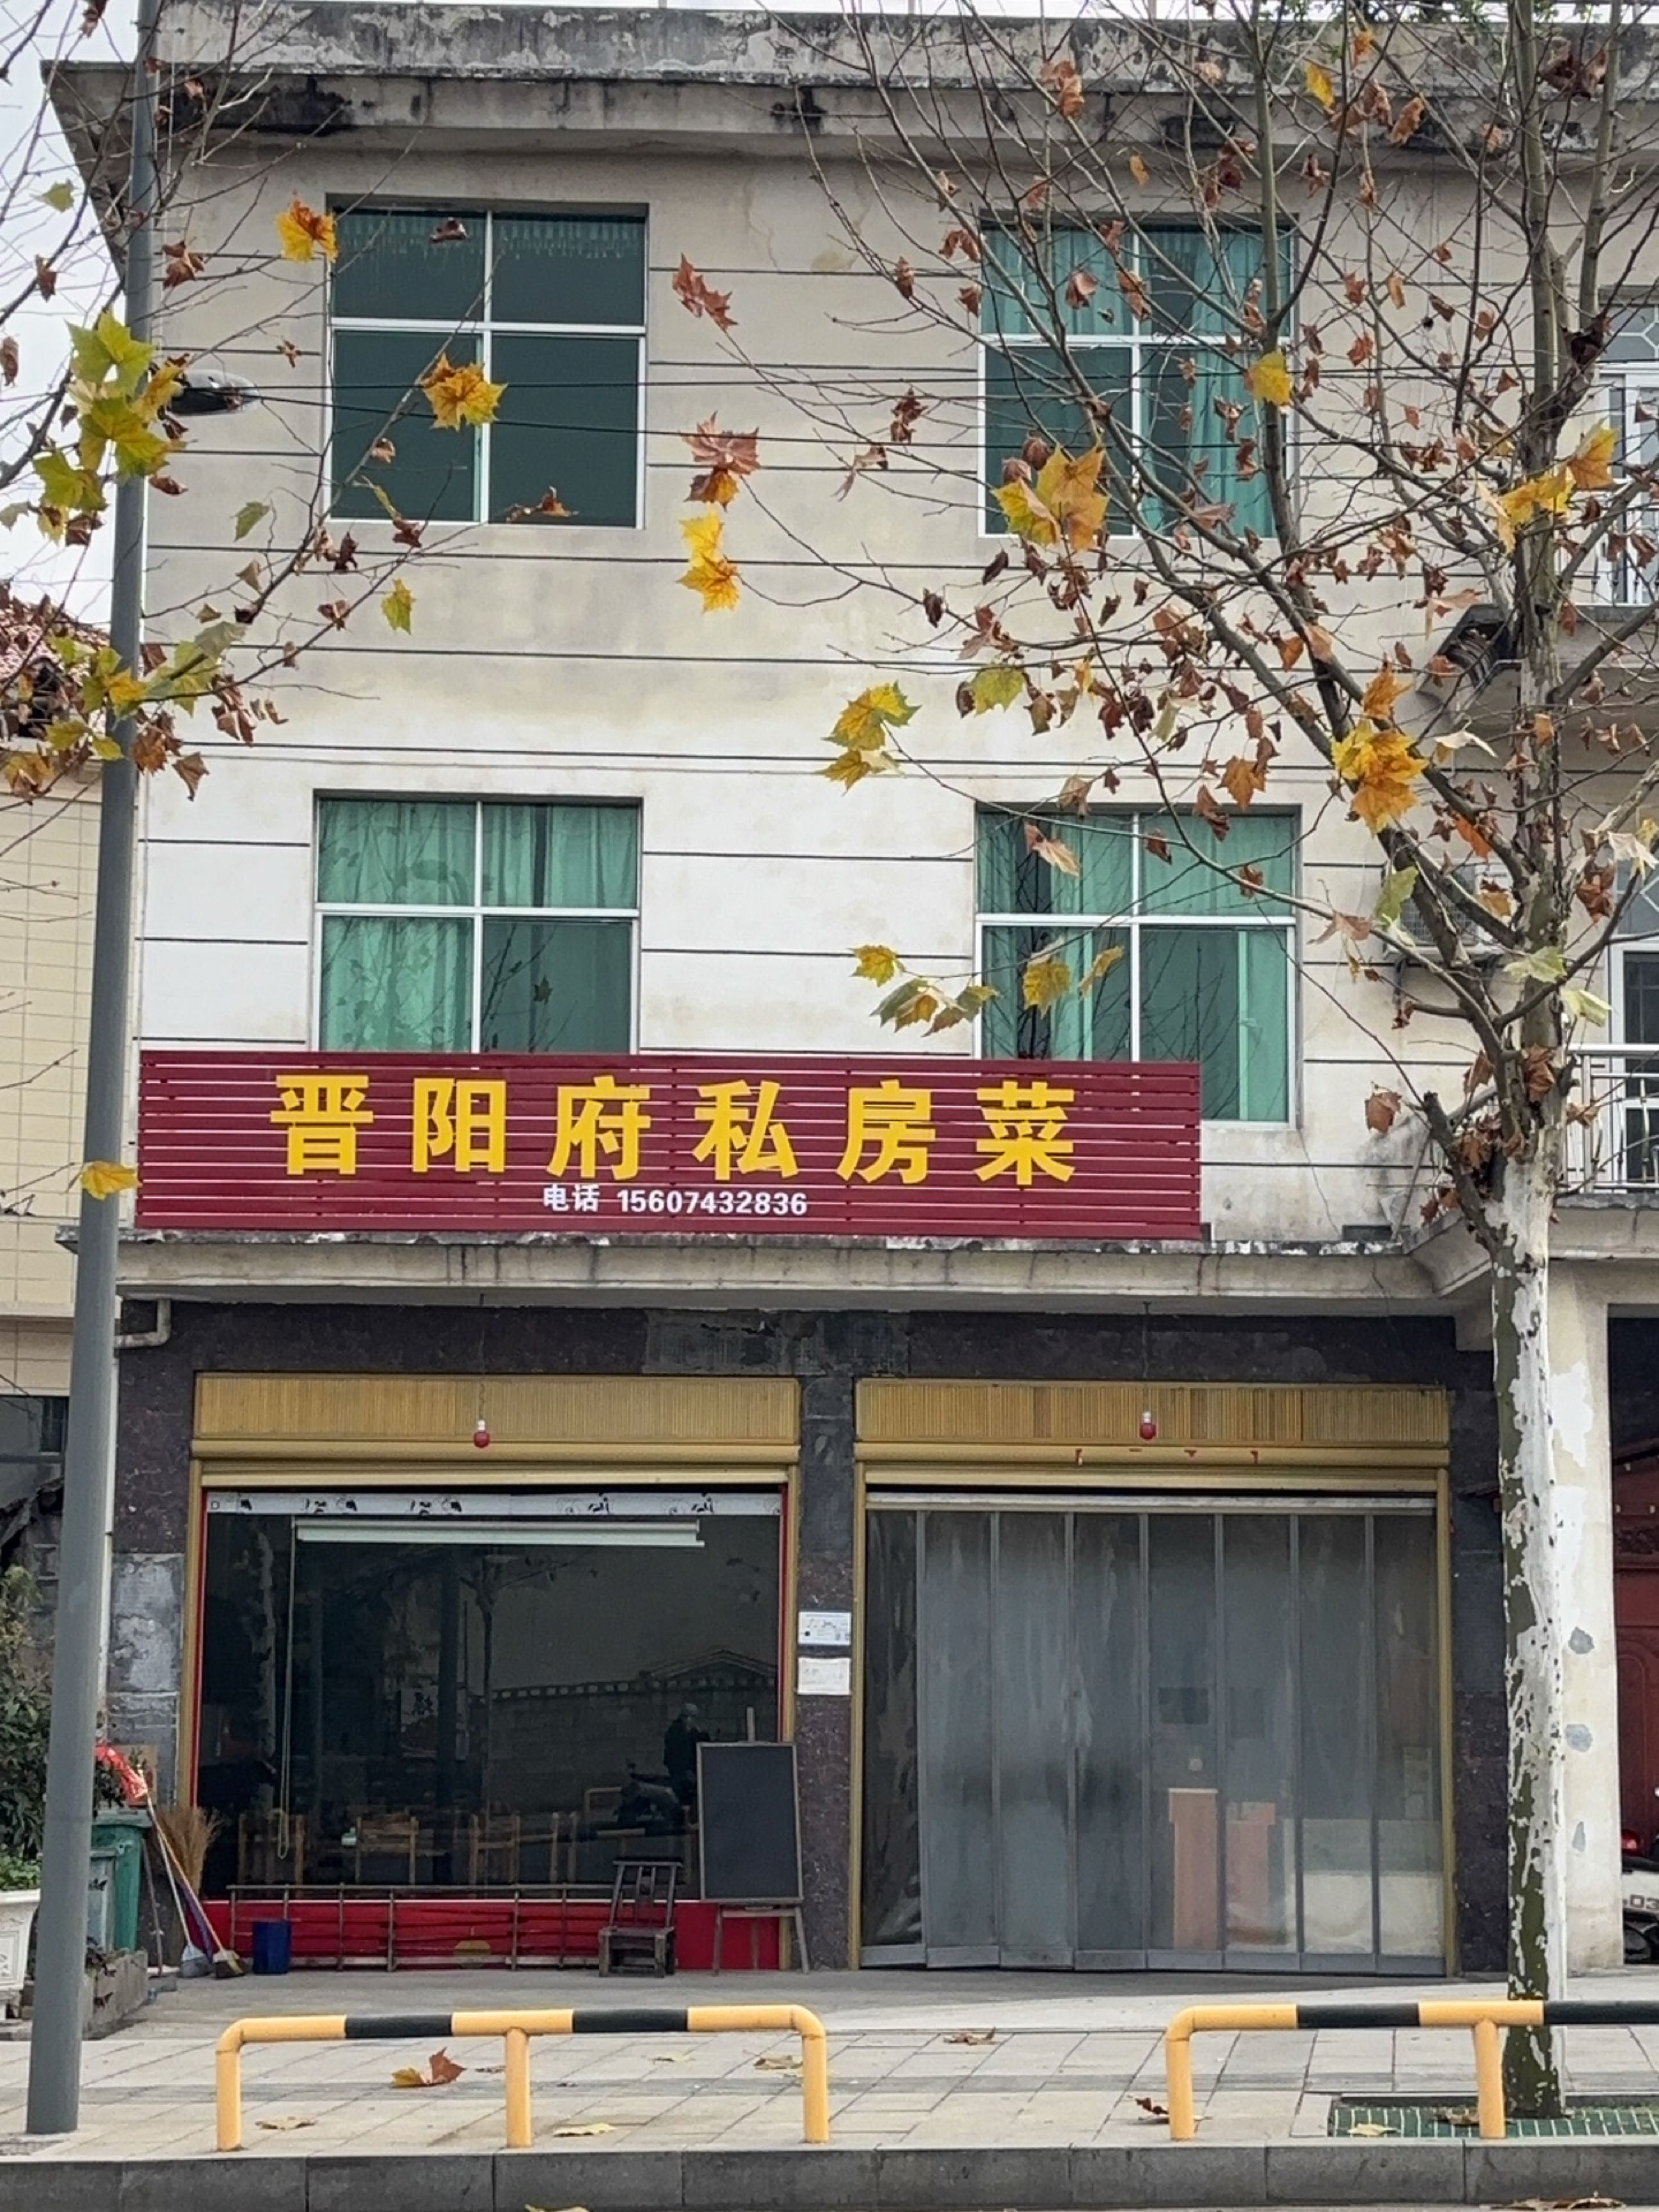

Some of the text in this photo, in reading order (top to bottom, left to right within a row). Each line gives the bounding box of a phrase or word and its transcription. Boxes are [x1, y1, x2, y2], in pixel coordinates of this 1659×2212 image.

[272, 1075, 1074, 1185] 晋阳府私房菜
[543, 1184, 808, 1215] 电话 15607432836
